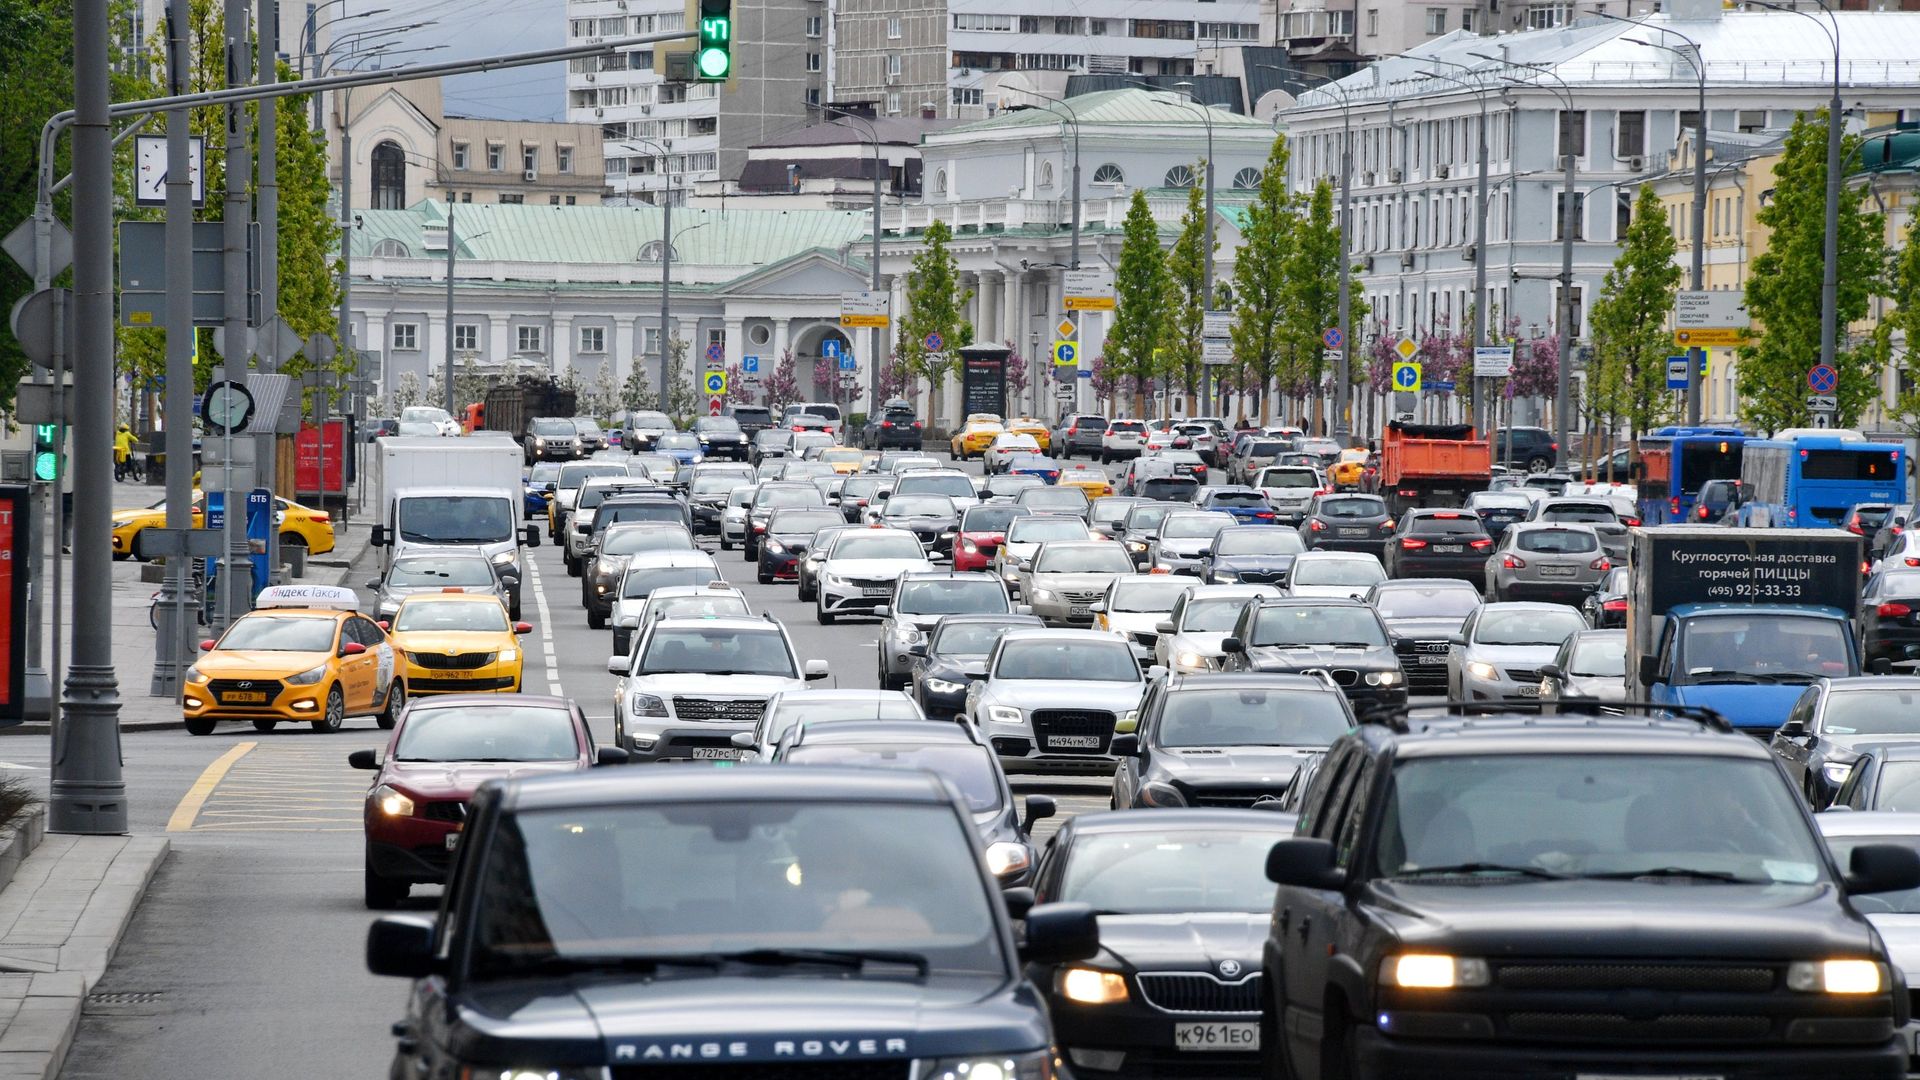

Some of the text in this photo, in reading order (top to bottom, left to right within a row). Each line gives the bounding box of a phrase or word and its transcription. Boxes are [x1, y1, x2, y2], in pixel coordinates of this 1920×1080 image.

[704, 20, 727, 39] 47
[251, 495, 267, 503] ВТБ
[1671, 550, 1837, 564] Круглосуточная доставка
[1699, 568, 1811, 581] горячей ПИЦЦЫ
[270, 587, 341, 599] Яндекс Такси
[1707, 584, 1801, 597] (495) 925-33-33
[1180, 1024, 1254, 1044] К961ЕО
[615, 1039, 906, 1059] RANGE ROVER
